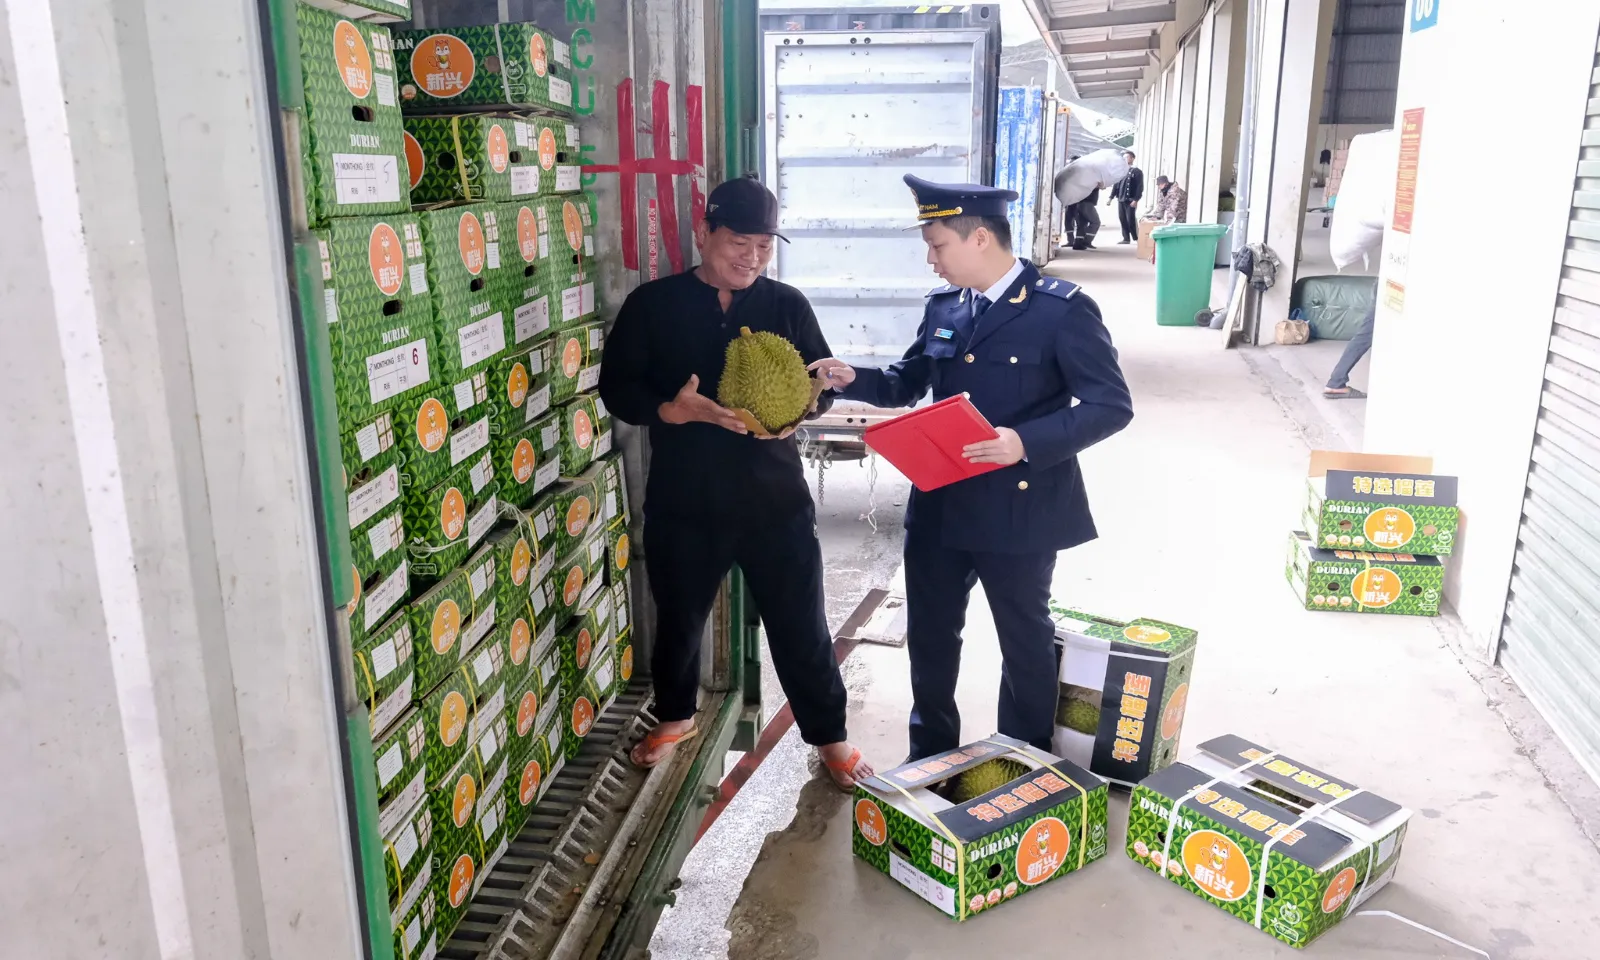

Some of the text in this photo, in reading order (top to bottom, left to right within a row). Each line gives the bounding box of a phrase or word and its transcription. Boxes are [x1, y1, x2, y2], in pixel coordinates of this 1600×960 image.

[345, 66, 368, 91] 新兴
[426, 72, 464, 91] 新兴
[350, 134, 380, 149] DURIAN
[648, 207, 655, 216] NO
[648, 216, 656, 234] CARGO
[649, 255, 657, 265] THIS
[378, 265, 401, 288] 新兴
[469, 301, 491, 318] DURIAN
[381, 325, 410, 344] DURIAN
[373, 357, 395, 371] MONTHONG
[412, 347, 419, 366] 6
[424, 427, 445, 449] 新兴
[389, 473, 396, 492] 3
[1353, 476, 1436, 498] 特选榴莲
[1328, 504, 1371, 515] DURIAN
[1373, 530, 1404, 545] 新兴
[1316, 566, 1358, 575] DURIAN
[1364, 591, 1391, 603] 新兴
[1112, 671, 1152, 764] 特选榴莲
[967, 772, 1072, 823] 特选榴莲
[1140, 796, 1193, 832] DURAN
[862, 821, 881, 842] 新兴
[970, 832, 1020, 862] DURIAN
[1027, 851, 1060, 880] 新兴
[1193, 863, 1235, 898] 新兴
[935, 886, 945, 901] 3
